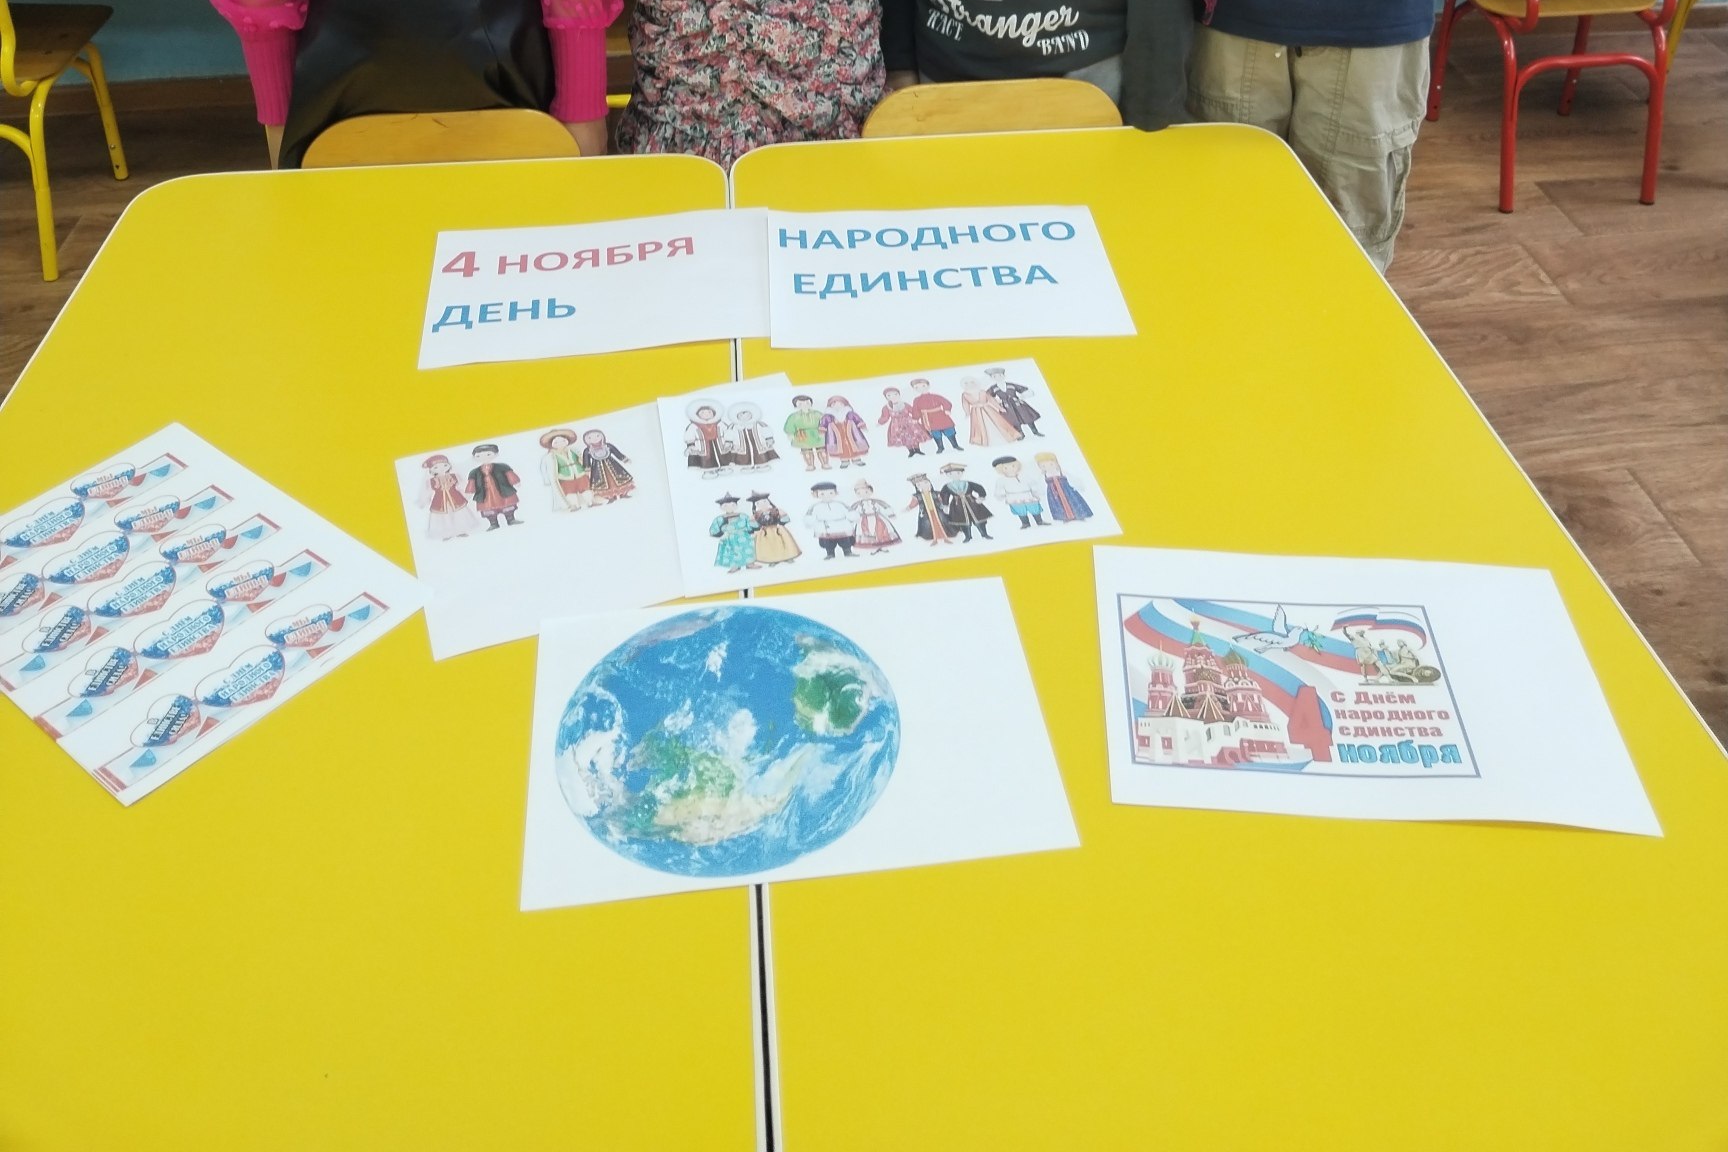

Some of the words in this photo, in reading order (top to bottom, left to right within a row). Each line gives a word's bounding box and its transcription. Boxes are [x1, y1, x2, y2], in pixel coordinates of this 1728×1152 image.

[926, 8, 965, 42] RACE
[1037, 29, 1090, 56] BAND
[778, 221, 1076, 252] НАРОДНОГО
[441, 250, 480, 278] 4
[496, 236, 695, 275] НОЯБРЯ
[793, 264, 1058, 299] ЕДИНСТВА
[432, 297, 577, 332] ДЕНЬ
[1354, 691, 1417, 706] Днём
[1335, 709, 1450, 723] народного
[1339, 724, 1444, 738] единства
[1337, 740, 1463, 769] ноября
